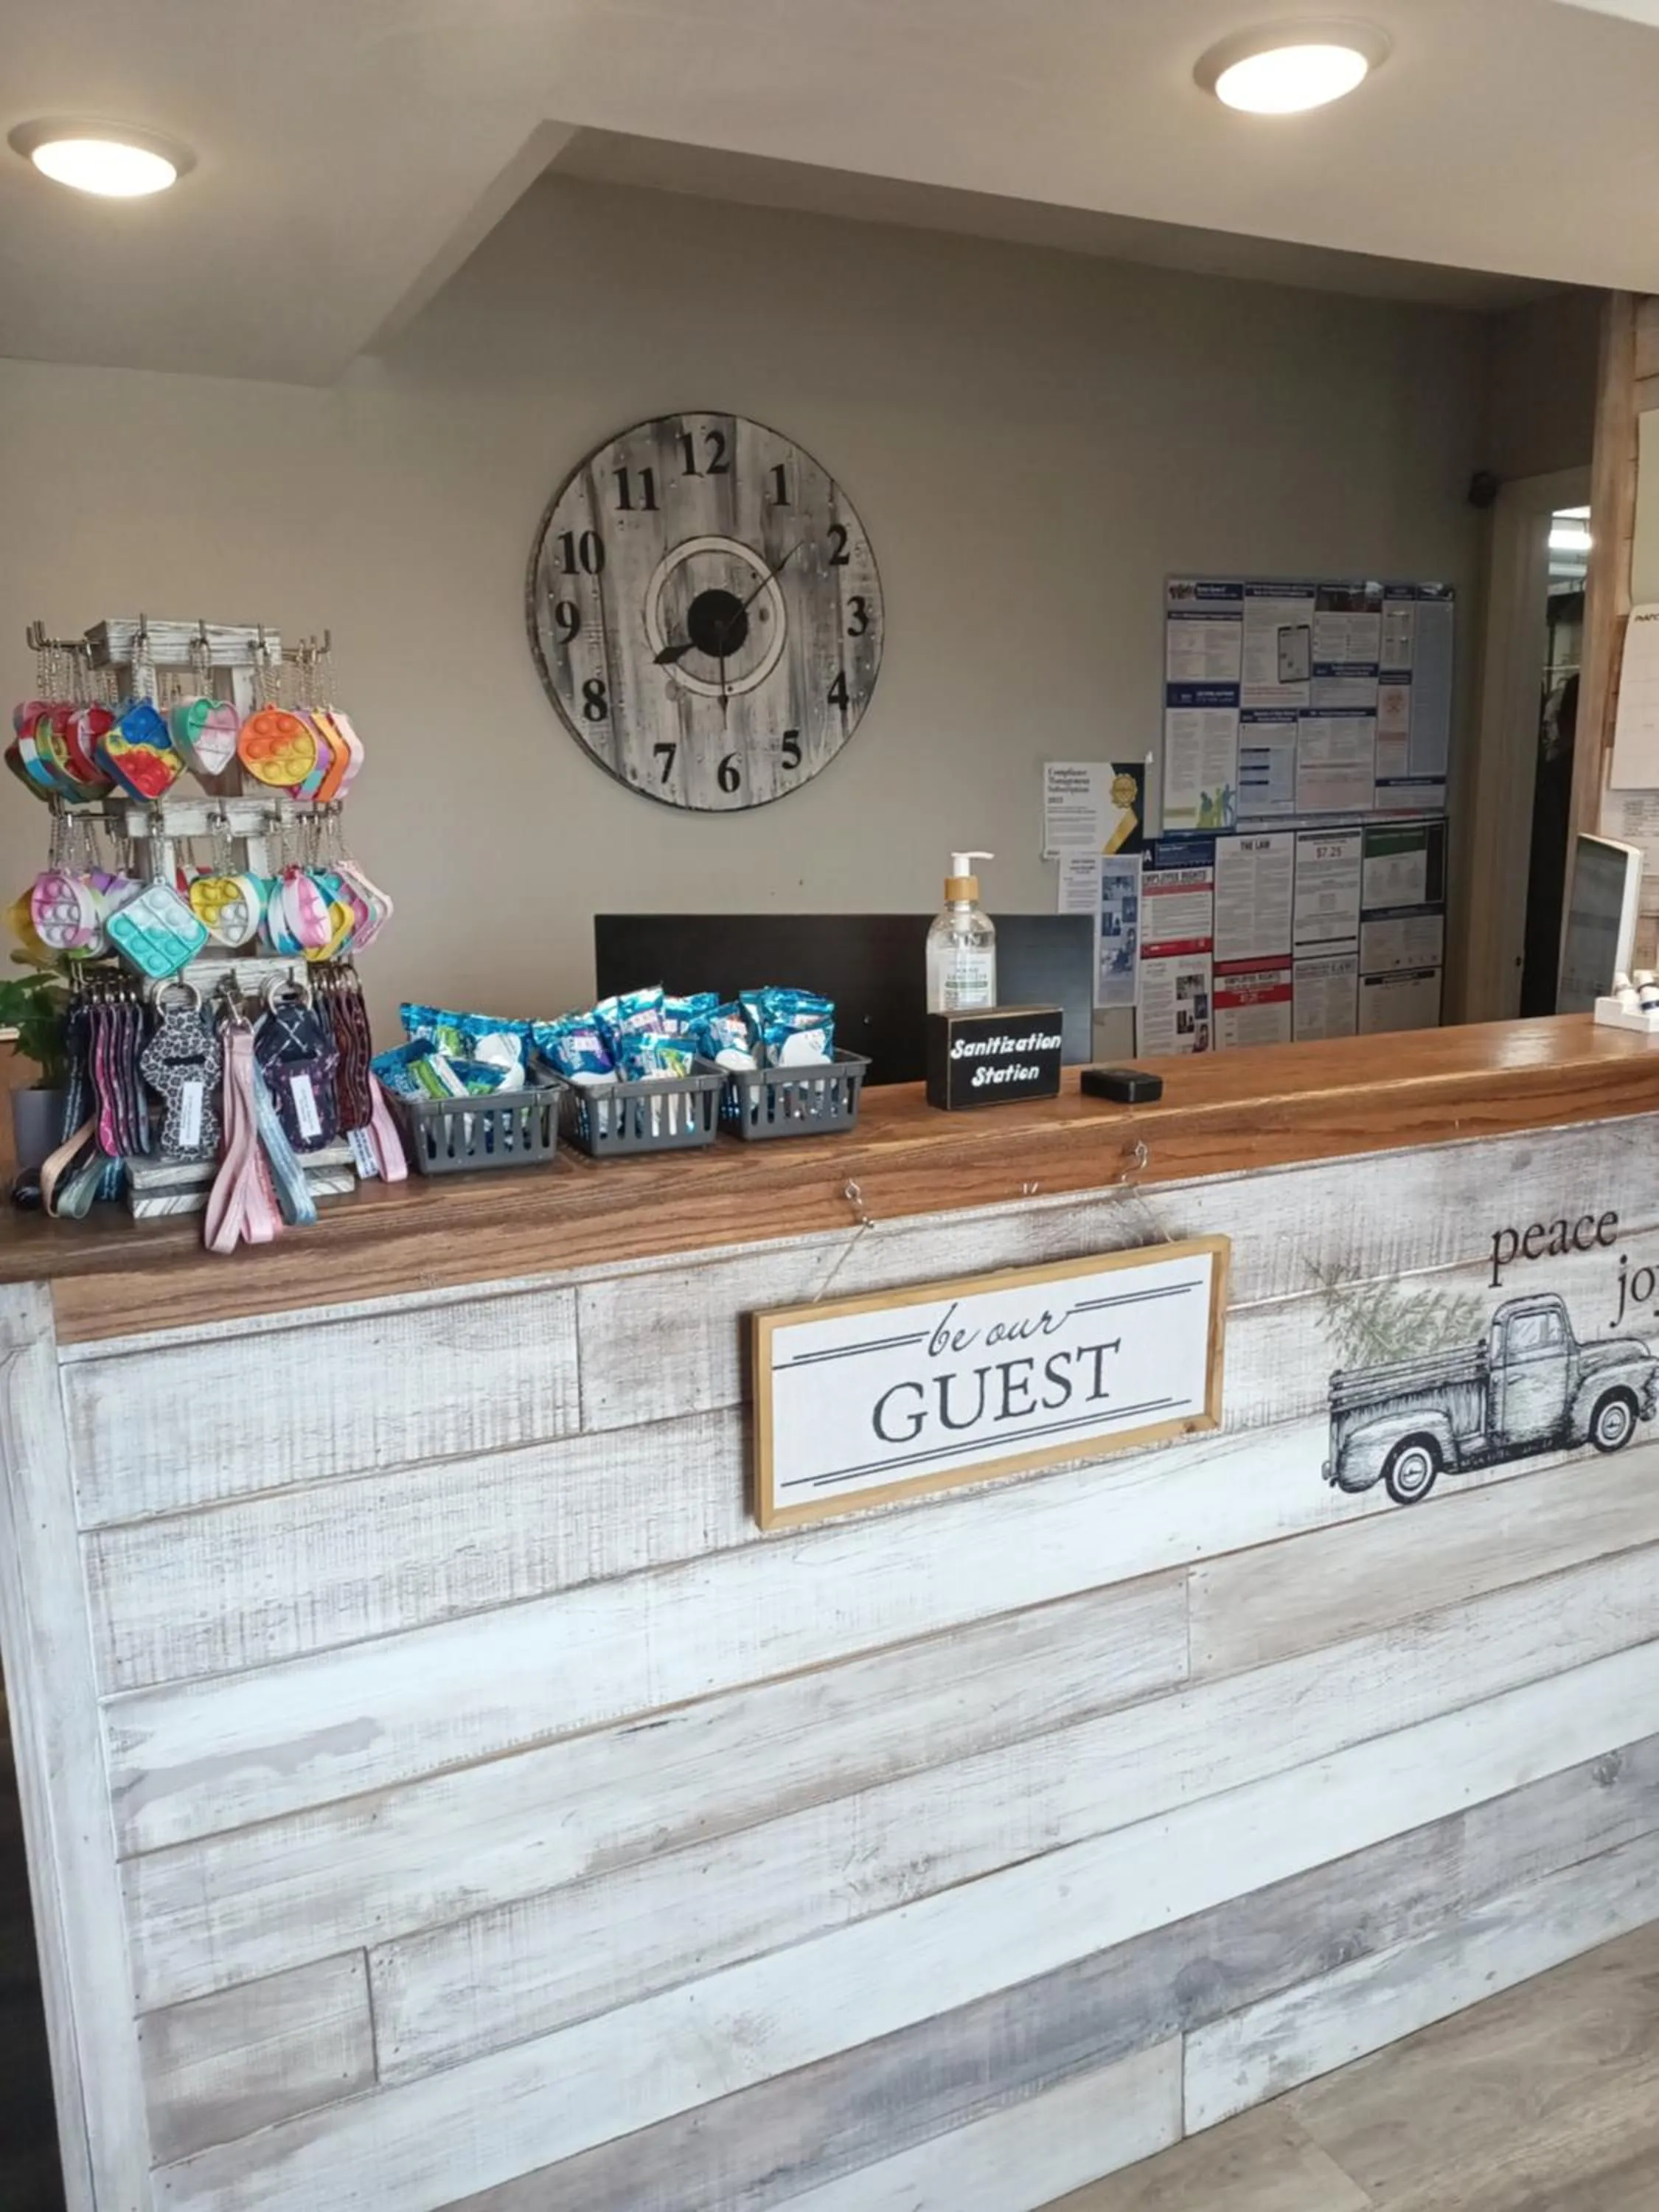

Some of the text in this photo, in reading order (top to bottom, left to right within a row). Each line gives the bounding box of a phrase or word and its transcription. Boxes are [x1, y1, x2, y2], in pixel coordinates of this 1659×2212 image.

[680, 431, 730, 477] 12
[613, 467, 661, 511] 11
[771, 464, 791, 506] 1
[558, 531, 605, 575] 10
[827, 524, 850, 566] 2
[555, 601, 580, 644] 9
[846, 596, 869, 636] 3
[581, 678, 608, 721] 8
[827, 671, 849, 710] 4
[653, 742, 677, 783] 7
[782, 729, 803, 770] 5
[717, 752, 740, 793] 6
[950, 1033, 1062, 1060] Sanitization
[971, 1063, 1040, 1087] Station
[1488, 1210, 1619, 1288] peace
[1610, 1254, 1659, 1328] jo
[928, 1303, 1071, 1357] be our
[872, 1338, 1121, 1443] GUEST
